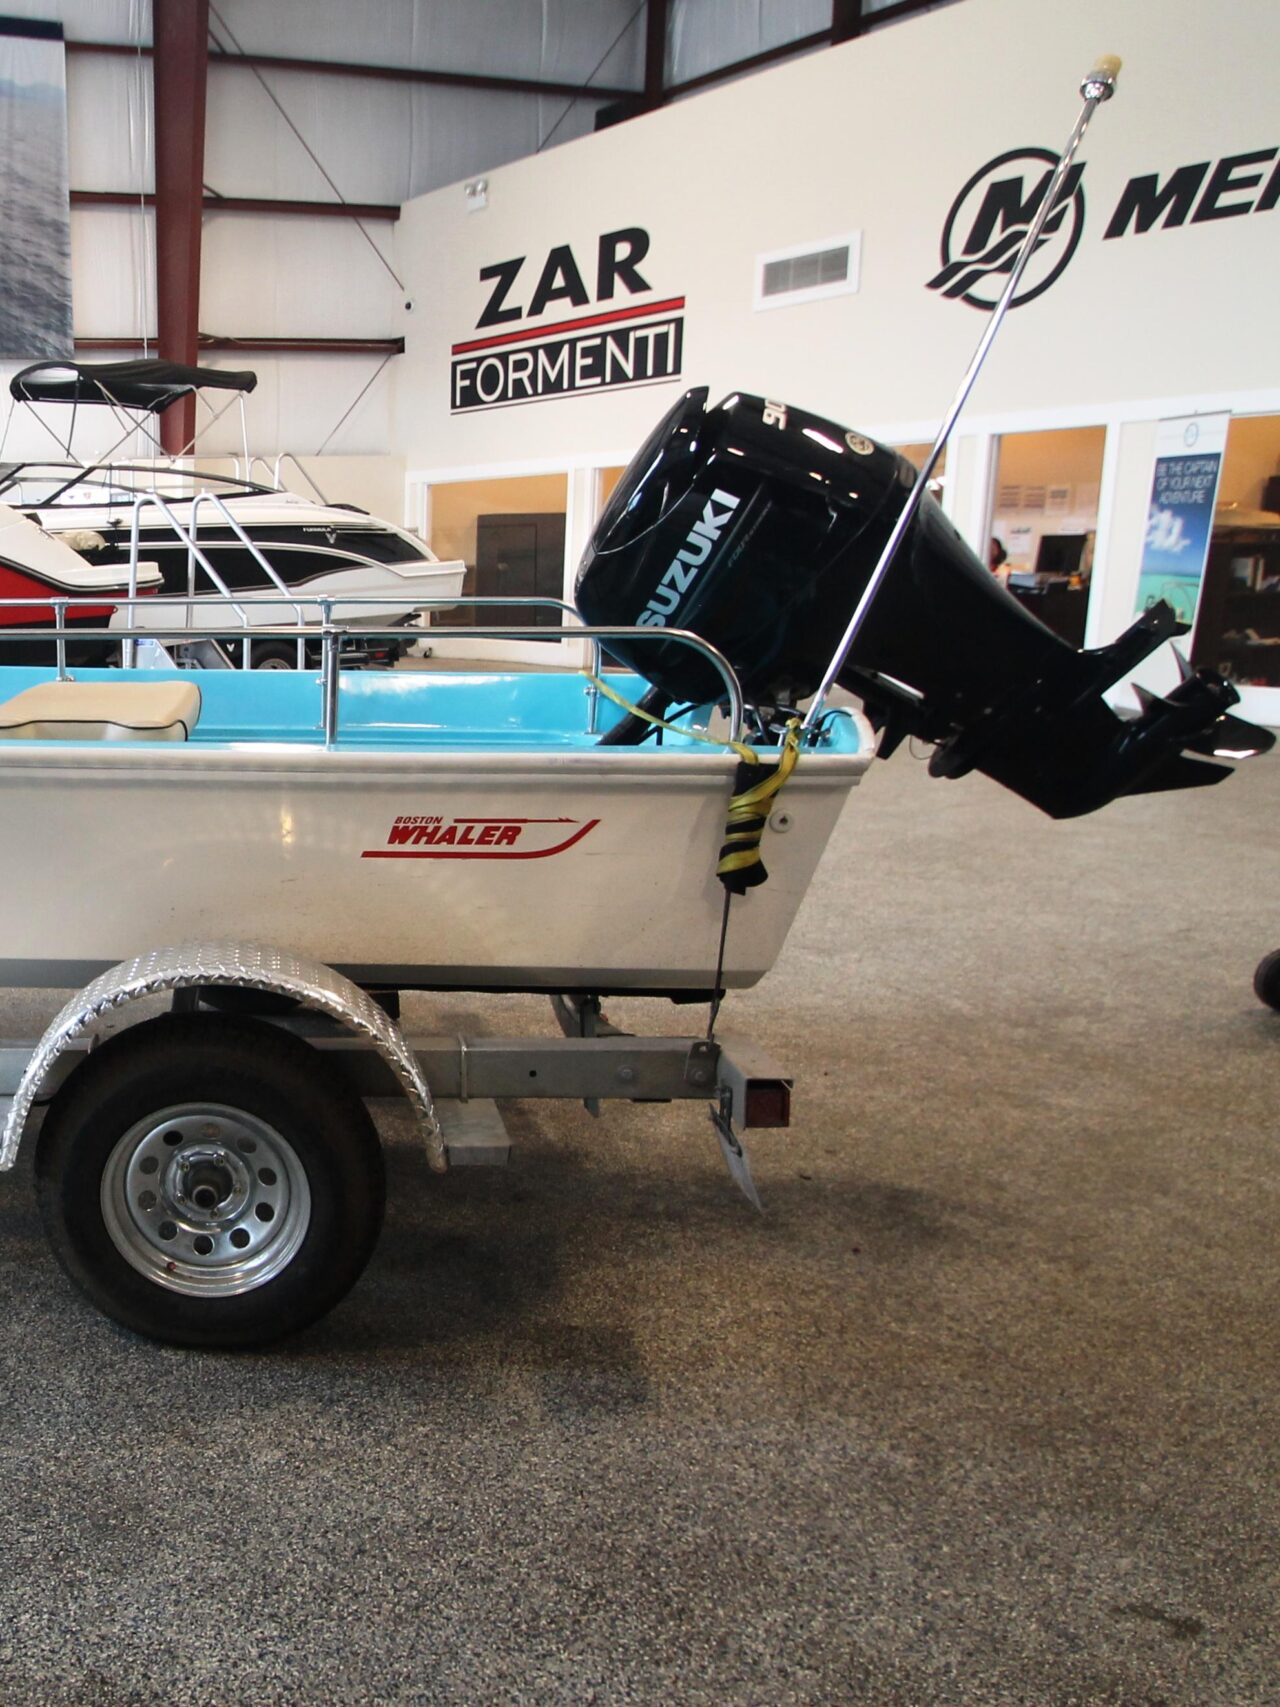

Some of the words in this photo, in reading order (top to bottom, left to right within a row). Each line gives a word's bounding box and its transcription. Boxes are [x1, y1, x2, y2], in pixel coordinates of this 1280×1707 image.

[475, 226, 653, 330] ZAR
[456, 322, 676, 406] FORMENTI
[1169, 461, 1183, 475] THE
[1184, 459, 1217, 474] CAPTAIN
[1190, 475, 1213, 488] NEXT
[636, 488, 741, 627] SUZUKI
[394, 816, 444, 825] BOSTON
[387, 825, 522, 846] WHALER
